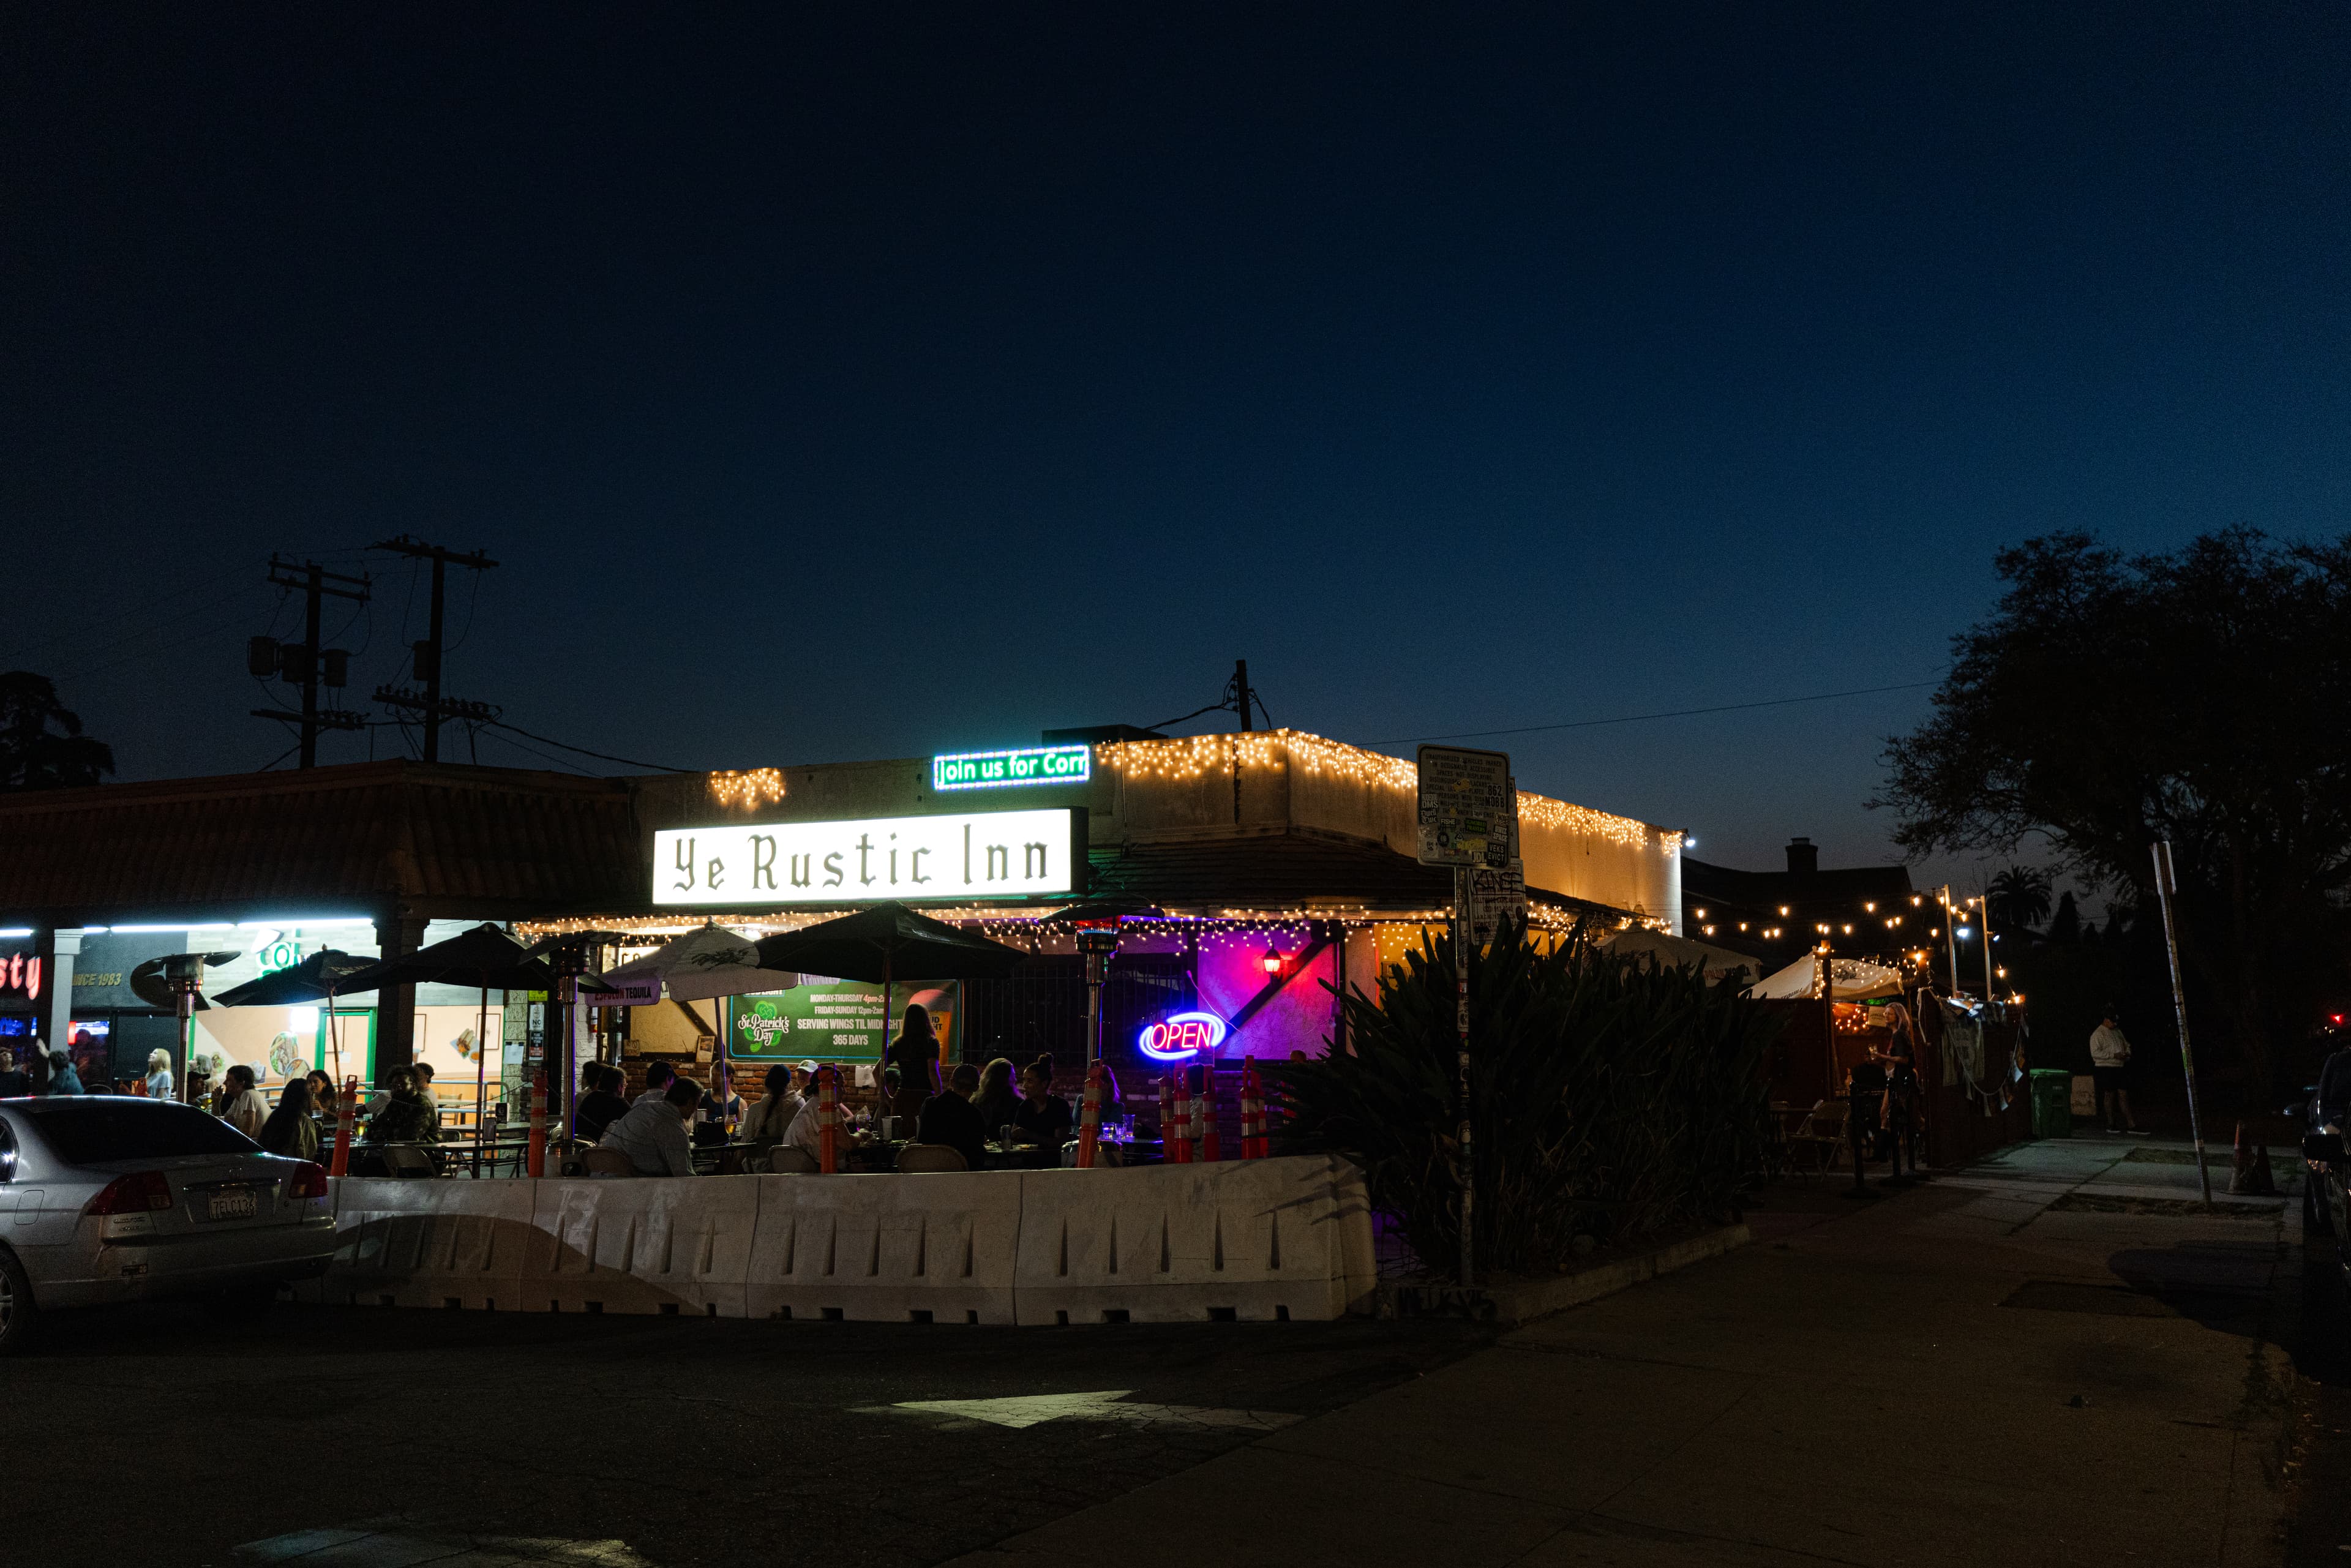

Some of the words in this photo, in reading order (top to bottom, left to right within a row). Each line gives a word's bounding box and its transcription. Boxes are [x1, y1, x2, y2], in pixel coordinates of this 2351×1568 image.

[982, 761, 1004, 778] us
[1009, 755, 1038, 776] for
[1488, 785, 1502, 796] 862
[1485, 797, 1505, 808] MOBB
[1489, 844, 1504, 853] VEKS
[673, 837, 725, 892] Ye
[748, 833, 932, 890] Rustic
[963, 823, 1048, 886] Inn
[1488, 852, 1504, 862] EVICT
[98, 972, 122, 986] 1983
[625, 986, 651, 999] TEQUILA
[810, 994, 863, 1003] MONDAY-THURSDAY
[815, 1006, 857, 1015] FRIDAY-SUNDAY
[797, 1018, 830, 1029] SERVING
[830, 1019, 855, 1029] WINGS
[855, 1019, 867, 1029] TIL
[753, 1027, 774, 1046] Day
[833, 1034, 847, 1046] 365
[849, 1034, 869, 1045] DAYS
[1150, 1022, 1212, 1049] OPEN
